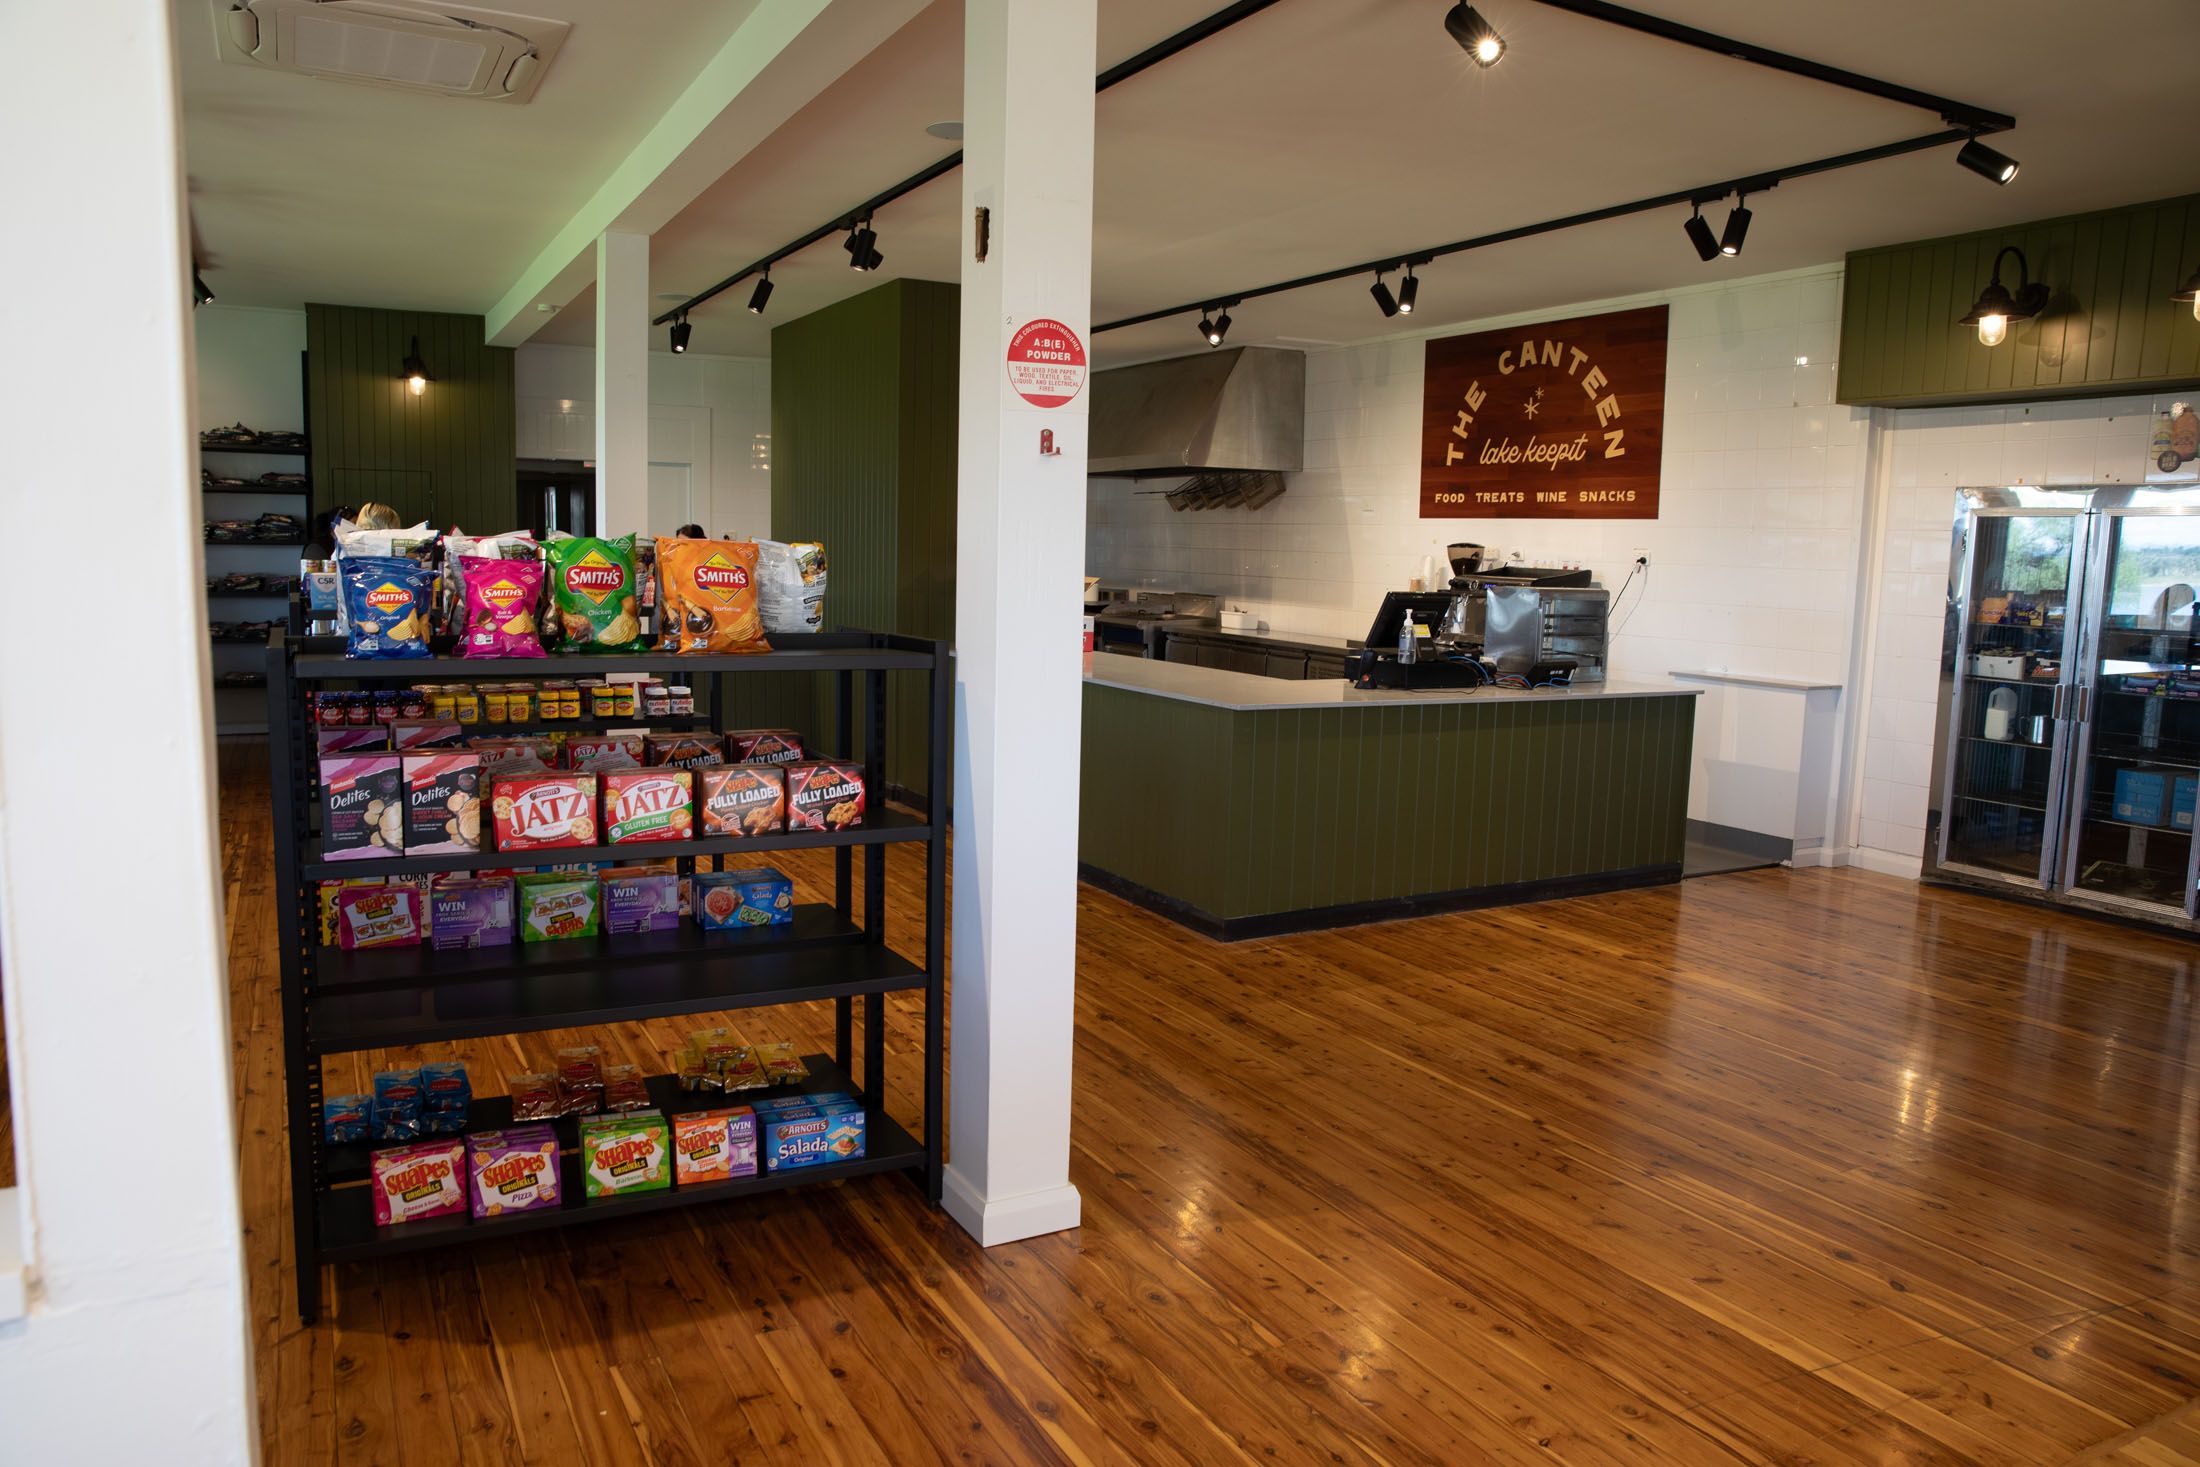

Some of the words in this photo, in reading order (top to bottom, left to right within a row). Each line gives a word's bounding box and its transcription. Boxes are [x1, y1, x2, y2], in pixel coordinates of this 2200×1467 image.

[1014, 334, 1023, 347] THIS
[1022, 322, 1049, 336] COLOURED
[1049, 322, 1080, 352] EXTINGUISHER
[1026, 349, 1072, 361] POWDER
[1048, 380, 1079, 388] ELECTRICAL
[1446, 379, 1488, 467] THE
[1498, 339, 1626, 460] CANTEEN
[1479, 436, 1522, 465] lake
[1521, 433, 1589, 471] keepit
[1434, 492, 1465, 504] FOOD
[1475, 491, 1525, 504] TREATS
[1536, 490, 1568, 503] WINE
[1579, 489, 1637, 502] SNACKS
[317, 577, 335, 585] CSR
[569, 568, 620, 585] SMITH'S
[697, 567, 746, 584] SMITH'S
[368, 591, 410, 603] SMITH'S
[484, 588, 524, 598] SMITH'S
[587, 608, 612, 616] Chicken
[480, 753, 500, 763] ATZ
[686, 753, 721, 770] LOADED
[767, 748, 801, 764] LOADED
[707, 792, 738, 810] FULLY
[739, 785, 781, 804] LOADED
[792, 788, 822, 806] FULLY
[823, 779, 863, 800] LOADED
[620, 784, 684, 821] JATZ
[511, 791, 588, 836] JATZ
[624, 818, 650, 831] GLUTEN
[651, 815, 668, 825] FREE
[613, 886, 640, 898] WIN
[438, 901, 466, 912] WIN
[730, 1120, 751, 1131] WIN
[788, 1121, 827, 1135] ARNOTT'S
[778, 1137, 829, 1160] Salada
[613, 1159, 646, 1176] ORIGINALS
[405, 1182, 441, 1201] ORIGINALS
[502, 1176, 537, 1194] ORIGINALS
[512, 1192, 533, 1203] Pizza
